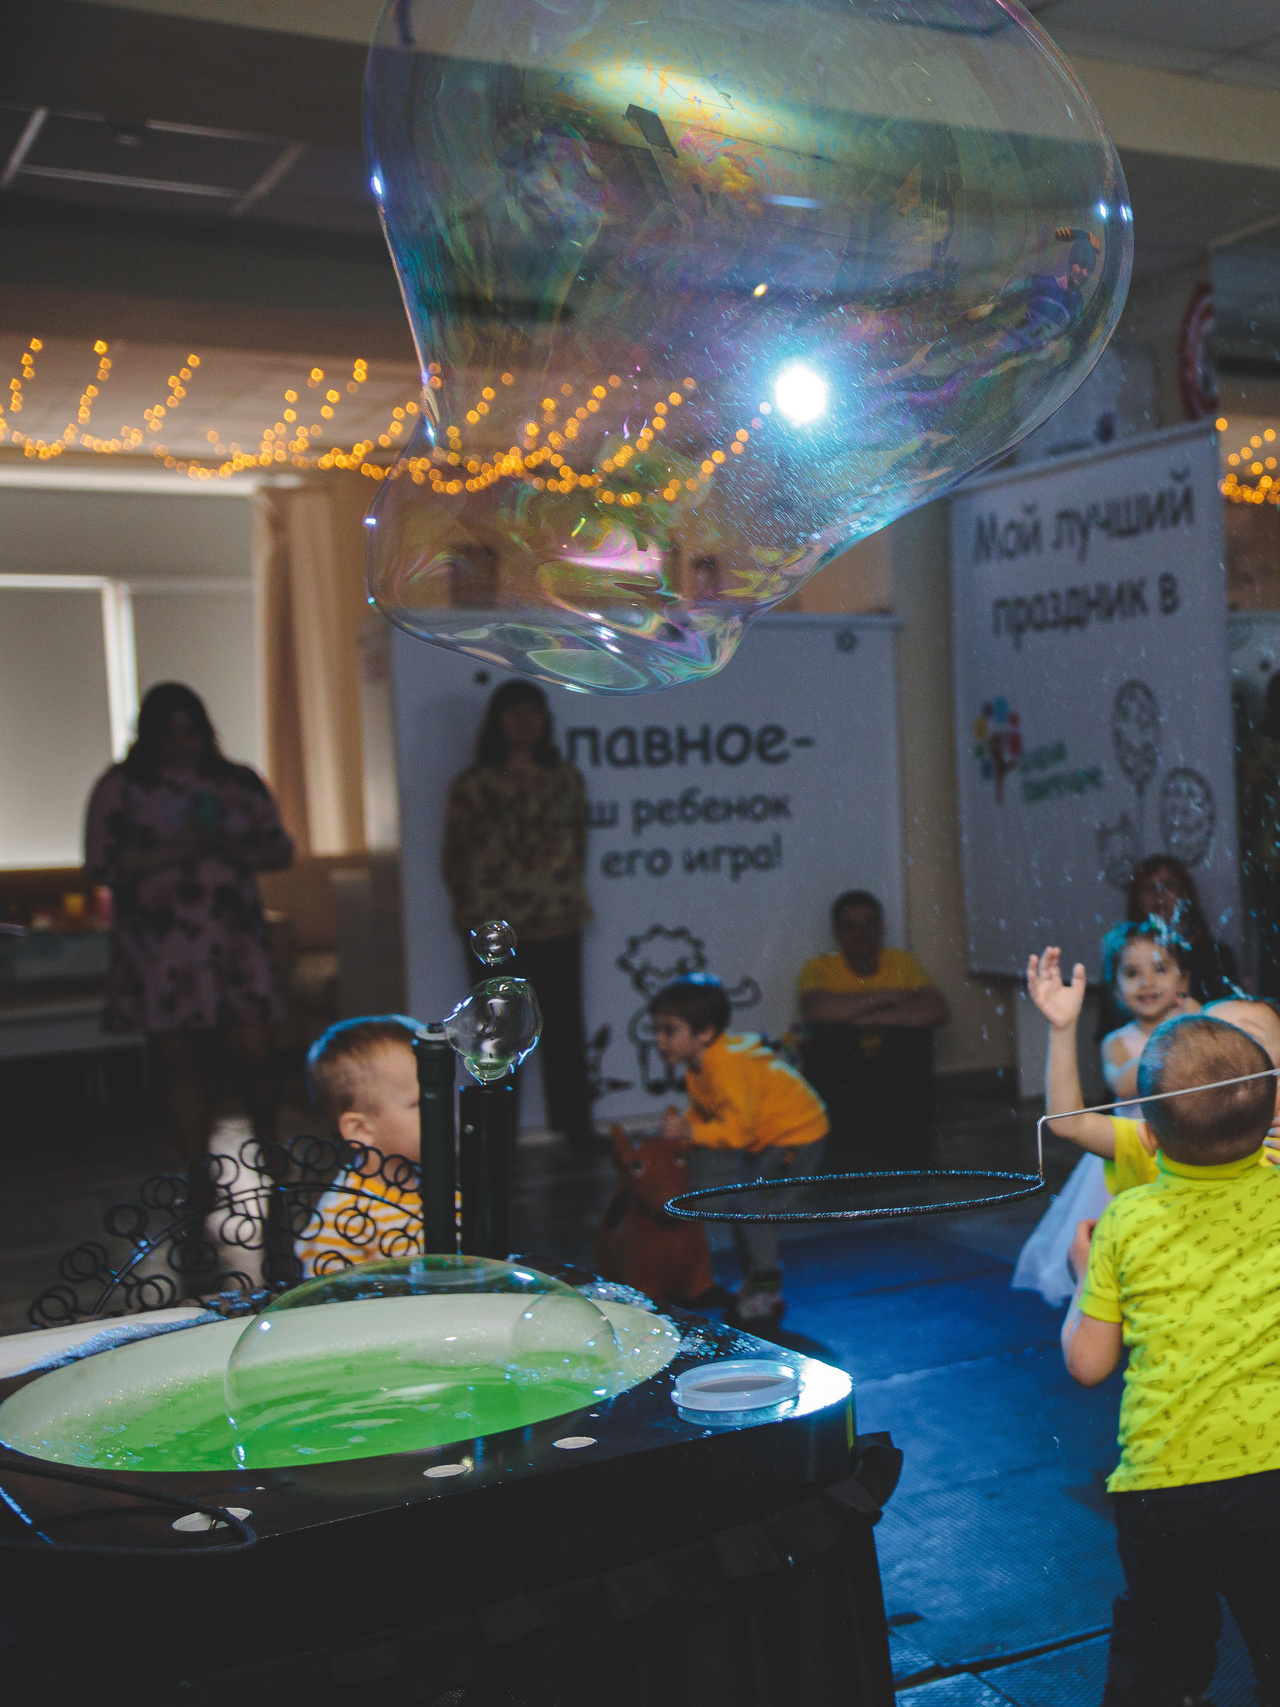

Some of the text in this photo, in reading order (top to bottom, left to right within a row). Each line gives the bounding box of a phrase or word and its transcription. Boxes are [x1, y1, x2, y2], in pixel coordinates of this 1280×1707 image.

[974, 467, 1195, 563] Мой лучший
[992, 577, 1148, 649] праздник
[566, 723, 815, 768] лавное-
